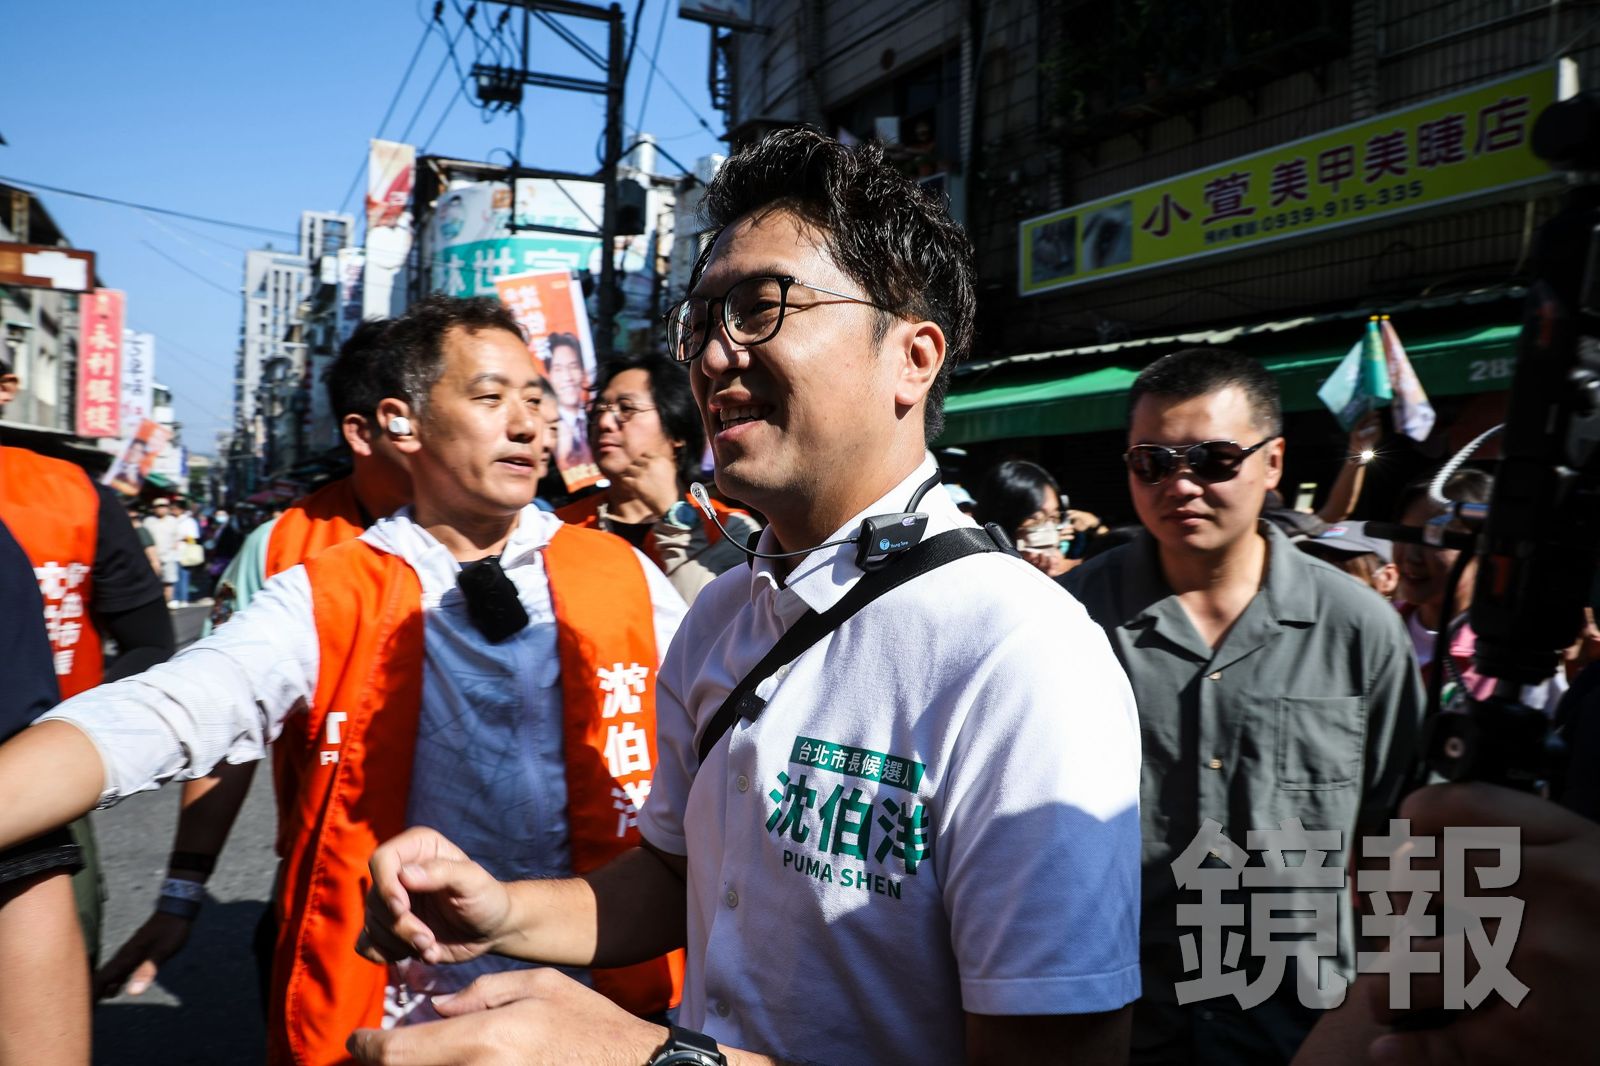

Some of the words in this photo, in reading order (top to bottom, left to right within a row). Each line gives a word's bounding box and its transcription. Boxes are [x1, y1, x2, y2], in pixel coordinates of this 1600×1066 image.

[1141, 96, 1531, 238] 小萱美甲美睫店
[1261, 180, 1424, 233] 0939-915-335
[797, 741, 911, 786] 台北市長候選人
[765, 771, 931, 875] 沈伯洋
[783, 849, 833, 883] PUMA
[840, 868, 902, 900] SHEN
